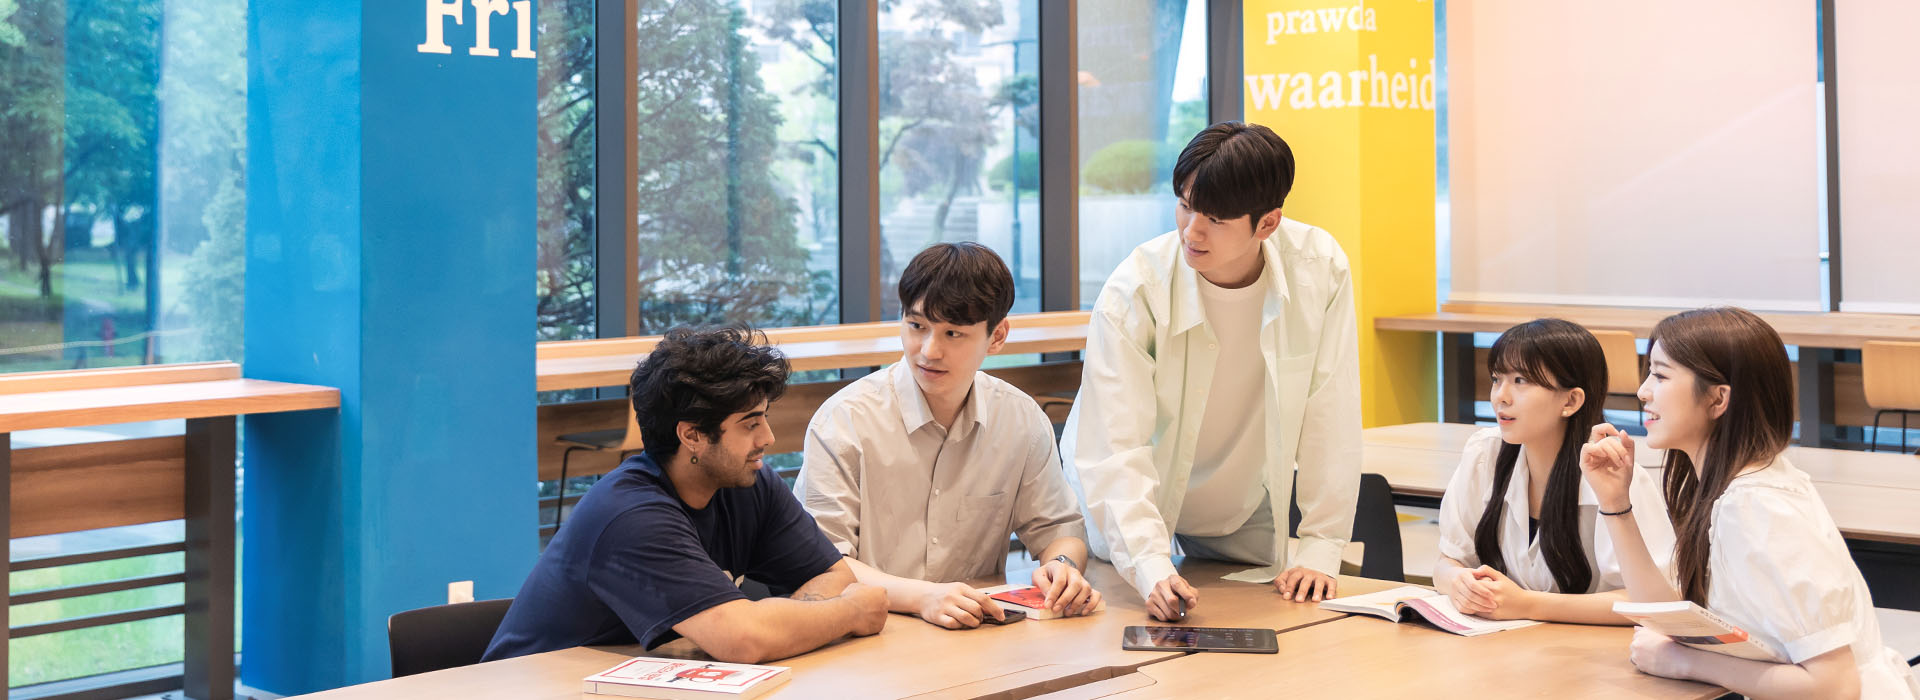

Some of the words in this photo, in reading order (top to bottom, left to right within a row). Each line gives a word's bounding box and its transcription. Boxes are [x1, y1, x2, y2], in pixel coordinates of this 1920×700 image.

[417, 0, 536, 58] Fri
[1265, 0, 1377, 45] prawda
[1244, 54, 1434, 110] waarheid
